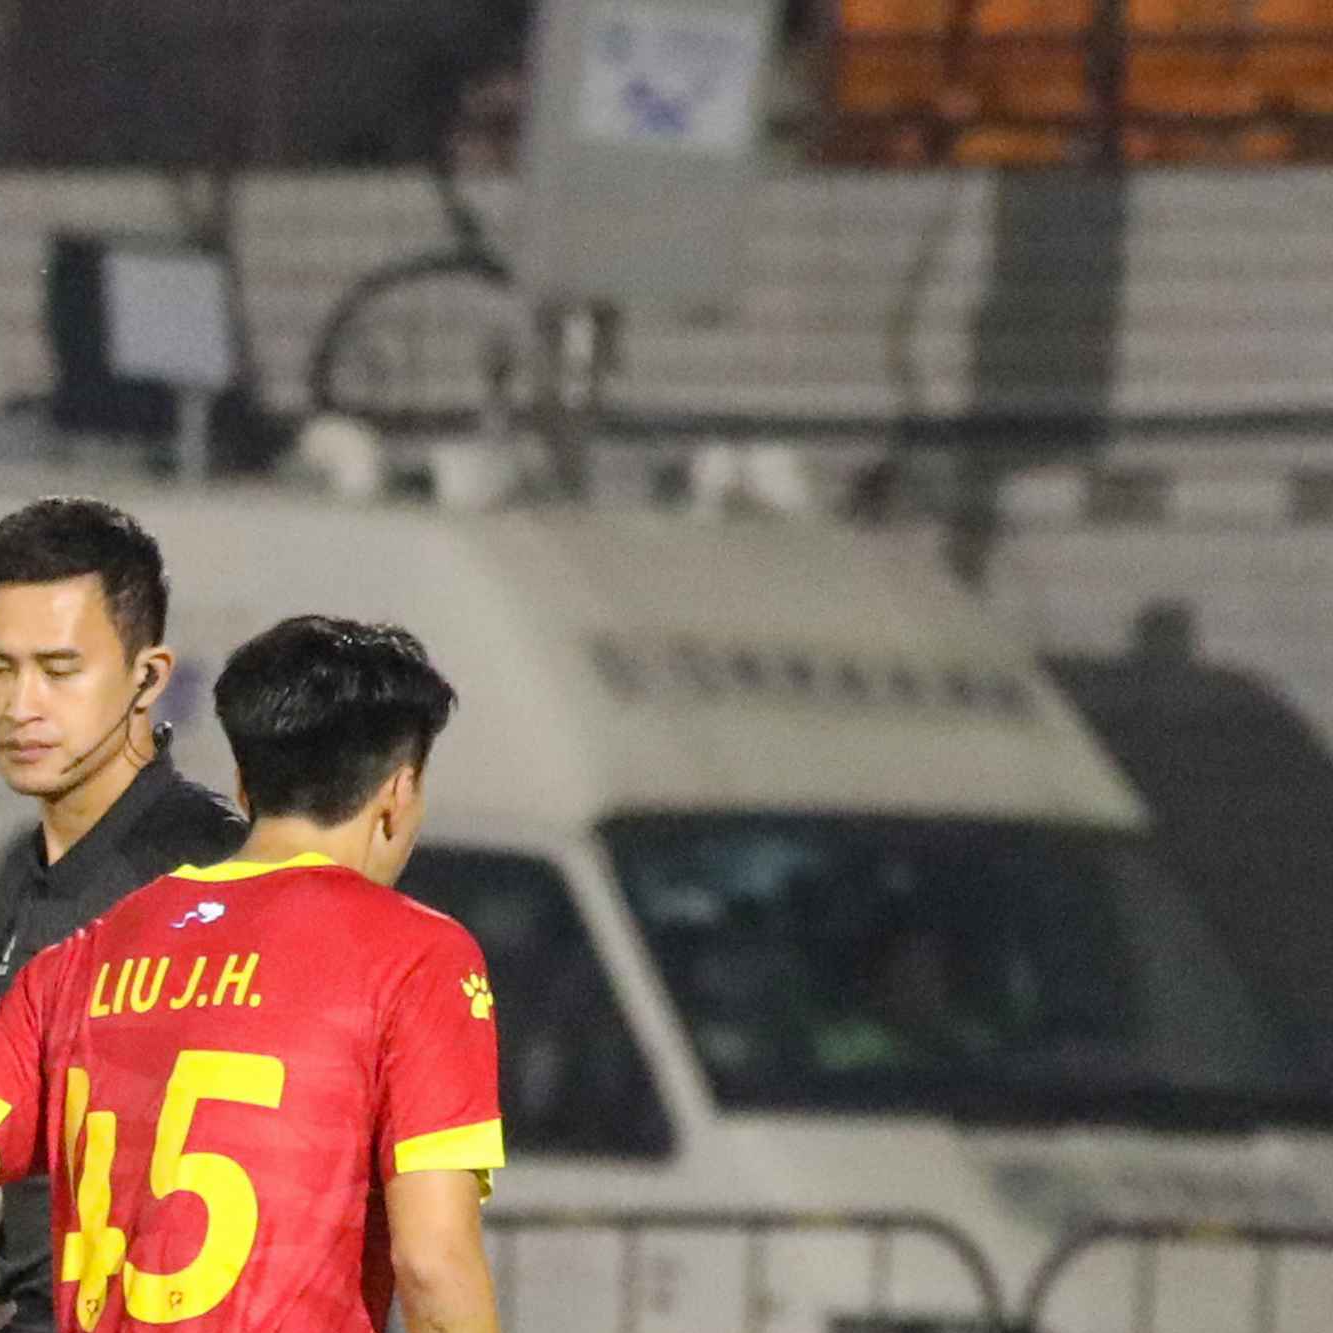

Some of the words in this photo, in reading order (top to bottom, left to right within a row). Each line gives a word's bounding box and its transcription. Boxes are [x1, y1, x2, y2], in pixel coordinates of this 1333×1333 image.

[88, 957, 171, 1018] LIU
[170, 952, 262, 1009] J.H.
[61, 1049, 286, 1333] 45
